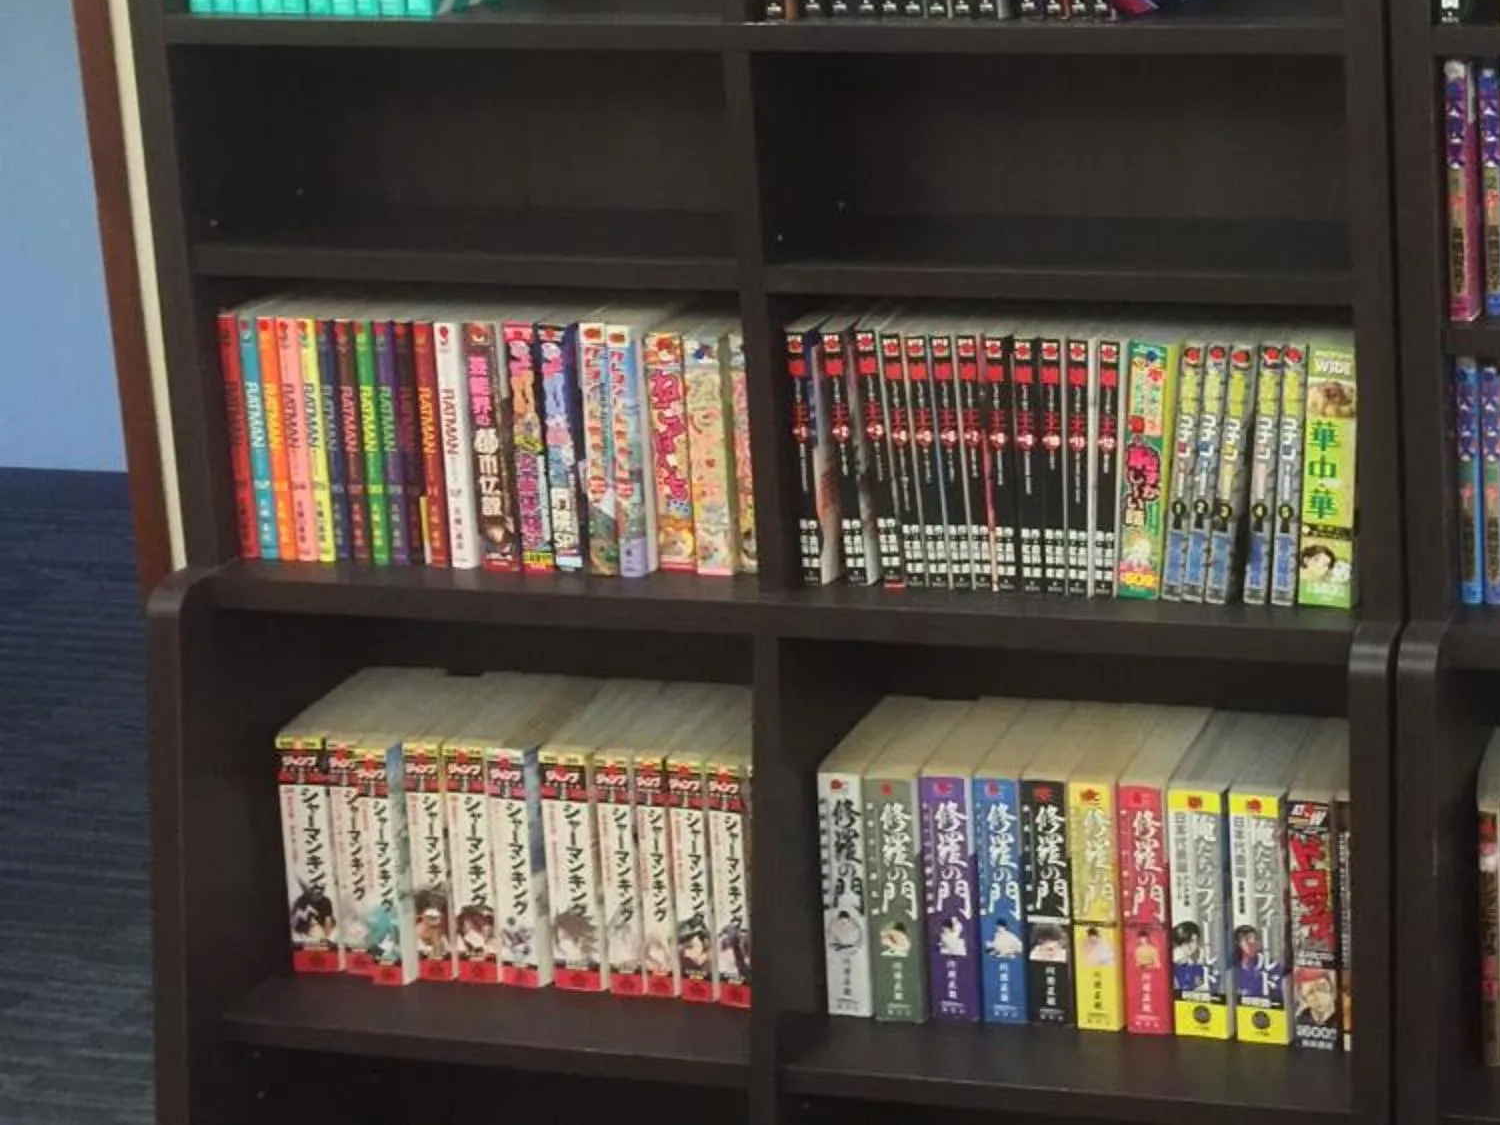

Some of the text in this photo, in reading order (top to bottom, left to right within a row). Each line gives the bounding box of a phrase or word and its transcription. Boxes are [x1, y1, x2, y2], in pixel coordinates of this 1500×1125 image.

[246, 382, 264, 449] RATMAN
[303, 383, 322, 448] RATMAN
[340, 386, 359, 453] RATMAN
[360, 386, 380, 453] RATMAN
[418, 387, 437, 454] RATMAN
[441, 389, 459, 457] RATMAN
[1309, 420, 1339, 518] 華中華
[301, 788, 326, 892] シャーマンキング
[344, 790, 366, 900] シャーマンキング
[373, 801, 393, 912] シャーマンキング
[423, 796, 442, 890] シャーマンキン
[465, 797, 487, 905] シャーマンキング
[507, 803, 528, 915] シャーマンキング
[563, 805, 588, 915] シャーマンキング
[613, 808, 634, 922] シャーマンキング
[649, 811, 667, 922] シャーマンキング
[725, 816, 742, 928] シャーマンキング
[832, 799, 865, 916] 修羅の門
[880, 802, 917, 921] 修羅の門
[935, 802, 971, 919] 修羅の門
[987, 802, 1021, 921] 修羅の門
[1035, 804, 1069, 916] 修羅の門
[1084, 809, 1114, 919] 修羅の門
[1131, 810, 1165, 923] 修羅の門
[1193, 814, 1217, 991] 俺たちのフィールド
[1253, 820, 1279, 995] 俺たちのフィールド
